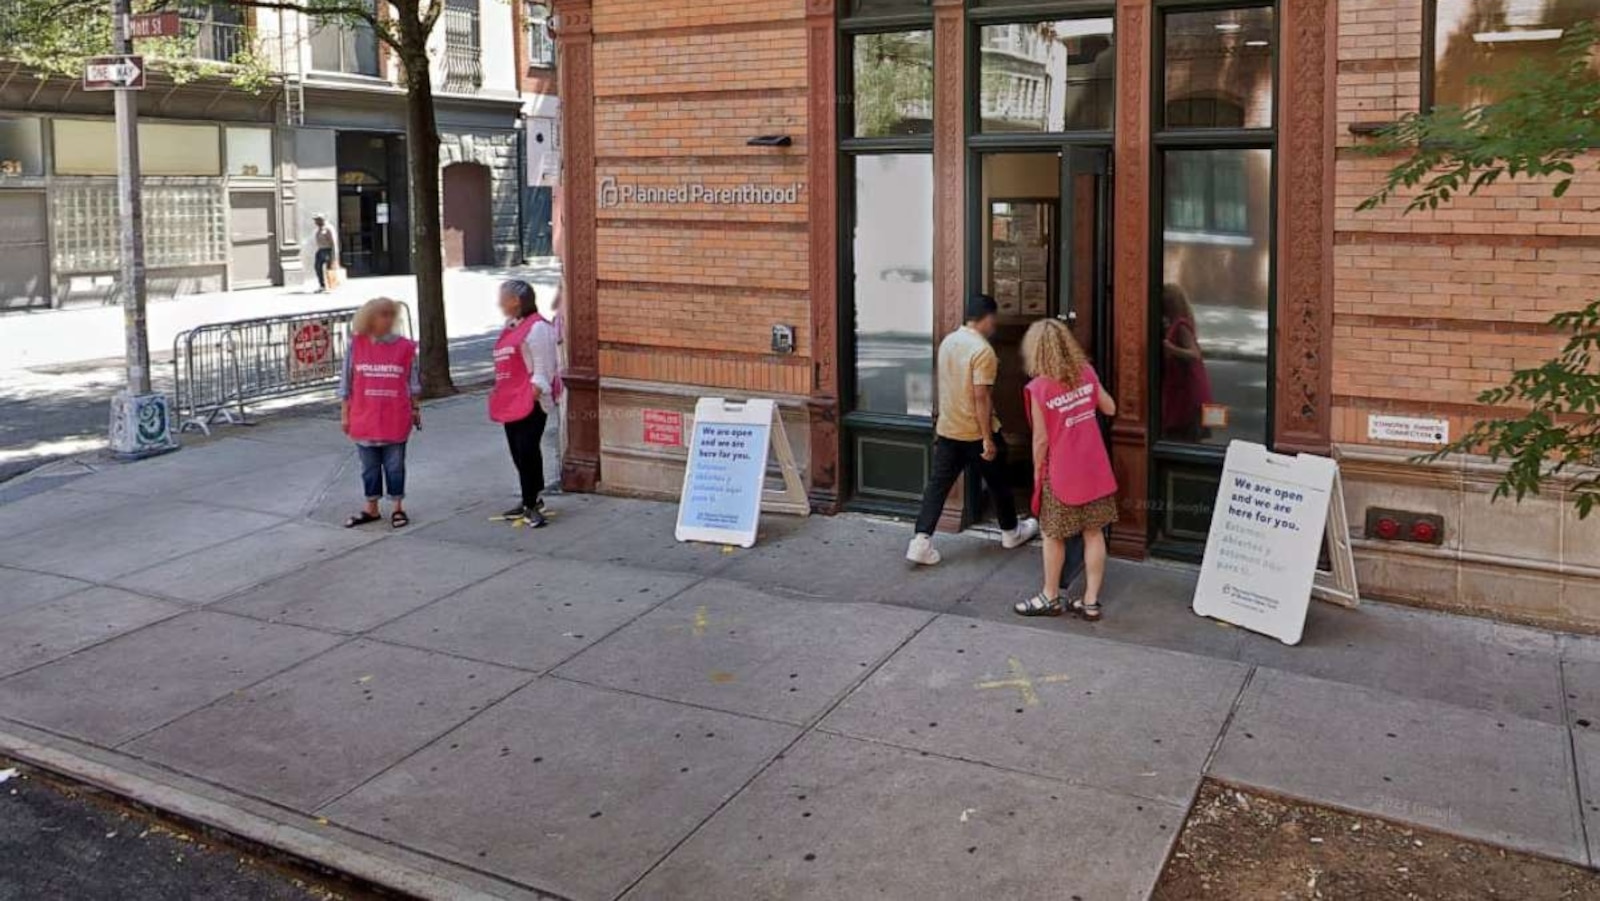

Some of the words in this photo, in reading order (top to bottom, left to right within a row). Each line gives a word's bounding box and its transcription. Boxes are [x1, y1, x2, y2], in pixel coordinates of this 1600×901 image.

[90, 66, 108, 79] ONE
[116, 65, 135, 79] WAY
[620, 184, 688, 204] Planned
[691, 183, 796, 204] Parenthood
[702, 427, 716, 435] We
[731, 429, 753, 439] open
[700, 438, 716, 446] and
[699, 450, 717, 458] here
[719, 450, 731, 458] for
[1235, 477, 1251, 490] We
[1254, 484, 1272, 494] are
[1274, 488, 1303, 502] open
[1231, 494, 1252, 504] and
[1255, 498, 1271, 509] we
[1273, 503, 1292, 514] are
[1228, 504, 1253, 520] here
[1256, 511, 1273, 525] for
[1274, 518, 1300, 532] you.
